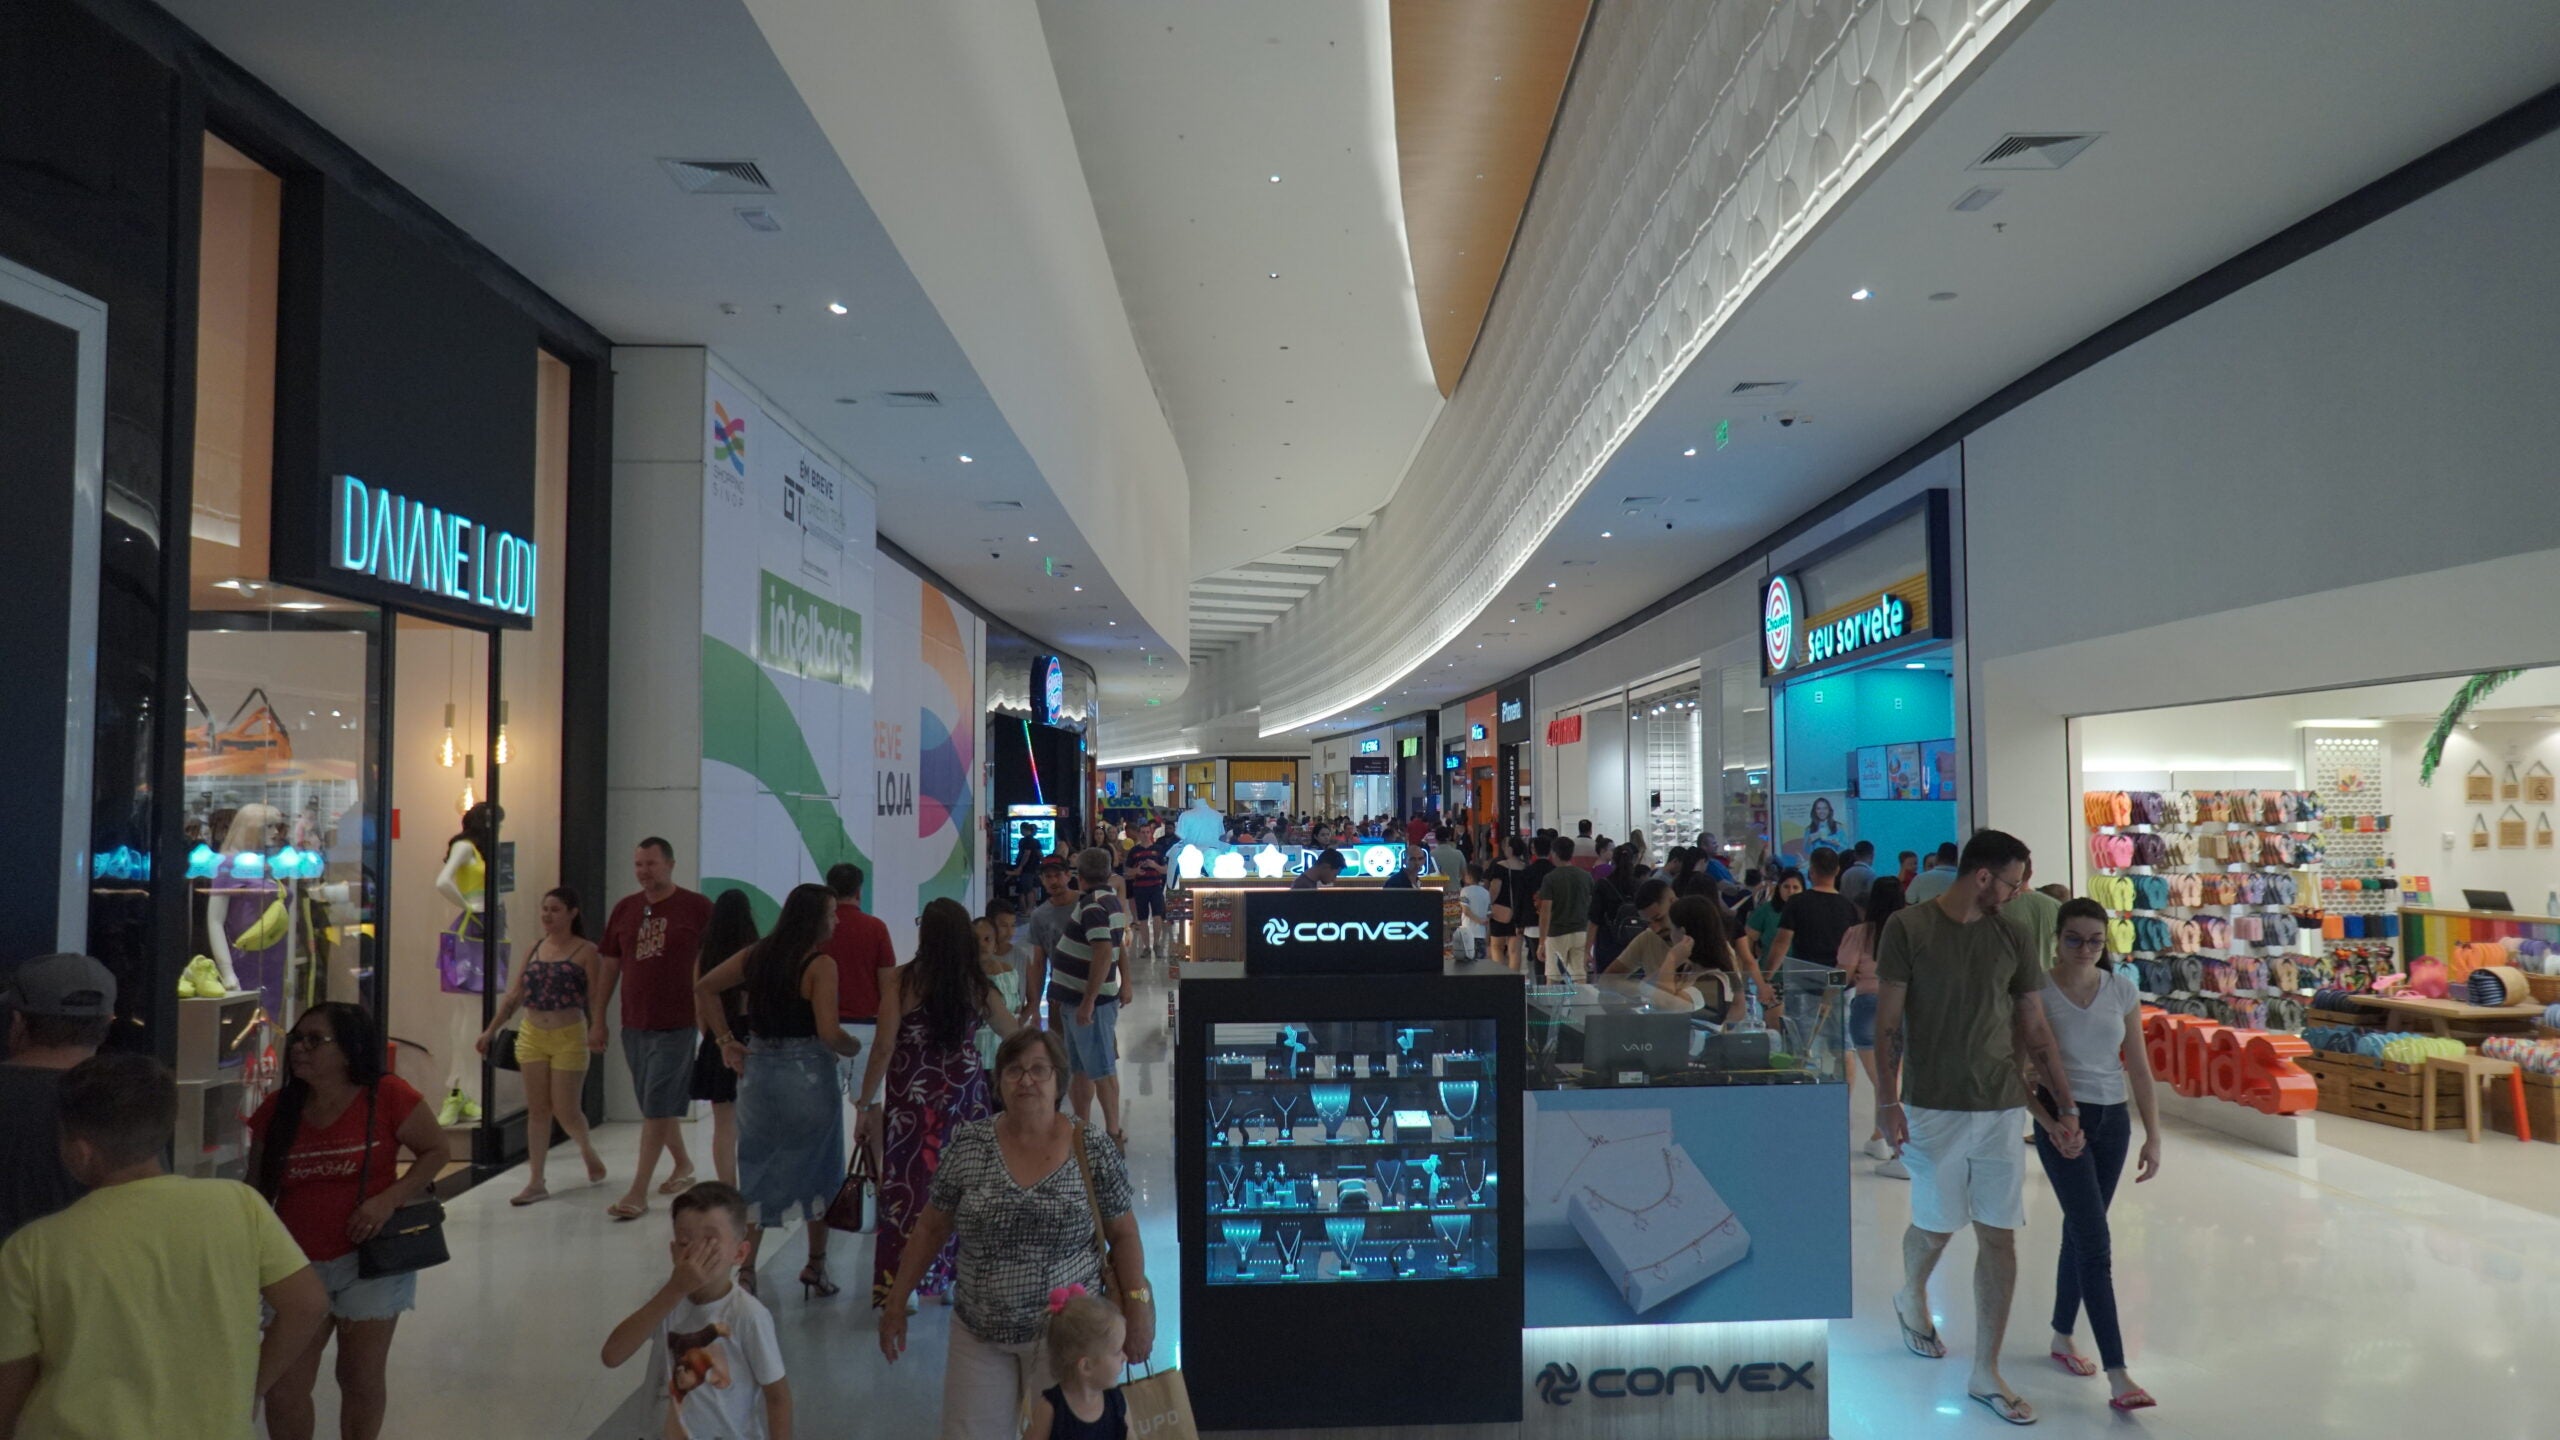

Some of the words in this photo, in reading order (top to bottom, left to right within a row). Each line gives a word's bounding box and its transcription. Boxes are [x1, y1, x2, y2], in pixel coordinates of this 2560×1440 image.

[811, 467, 834, 501] BREVE
[478, 522, 537, 617] LODI
[770, 584, 854, 674] intelbras
[1808, 624, 1835, 664] seu
[1836, 593, 1905, 655] sorvete
[877, 770, 913, 816] LOJA
[1293, 920, 1430, 942] CONVEX
[1621, 1042, 1654, 1052] VAIO
[1587, 1360, 1815, 1399] CONVEX
